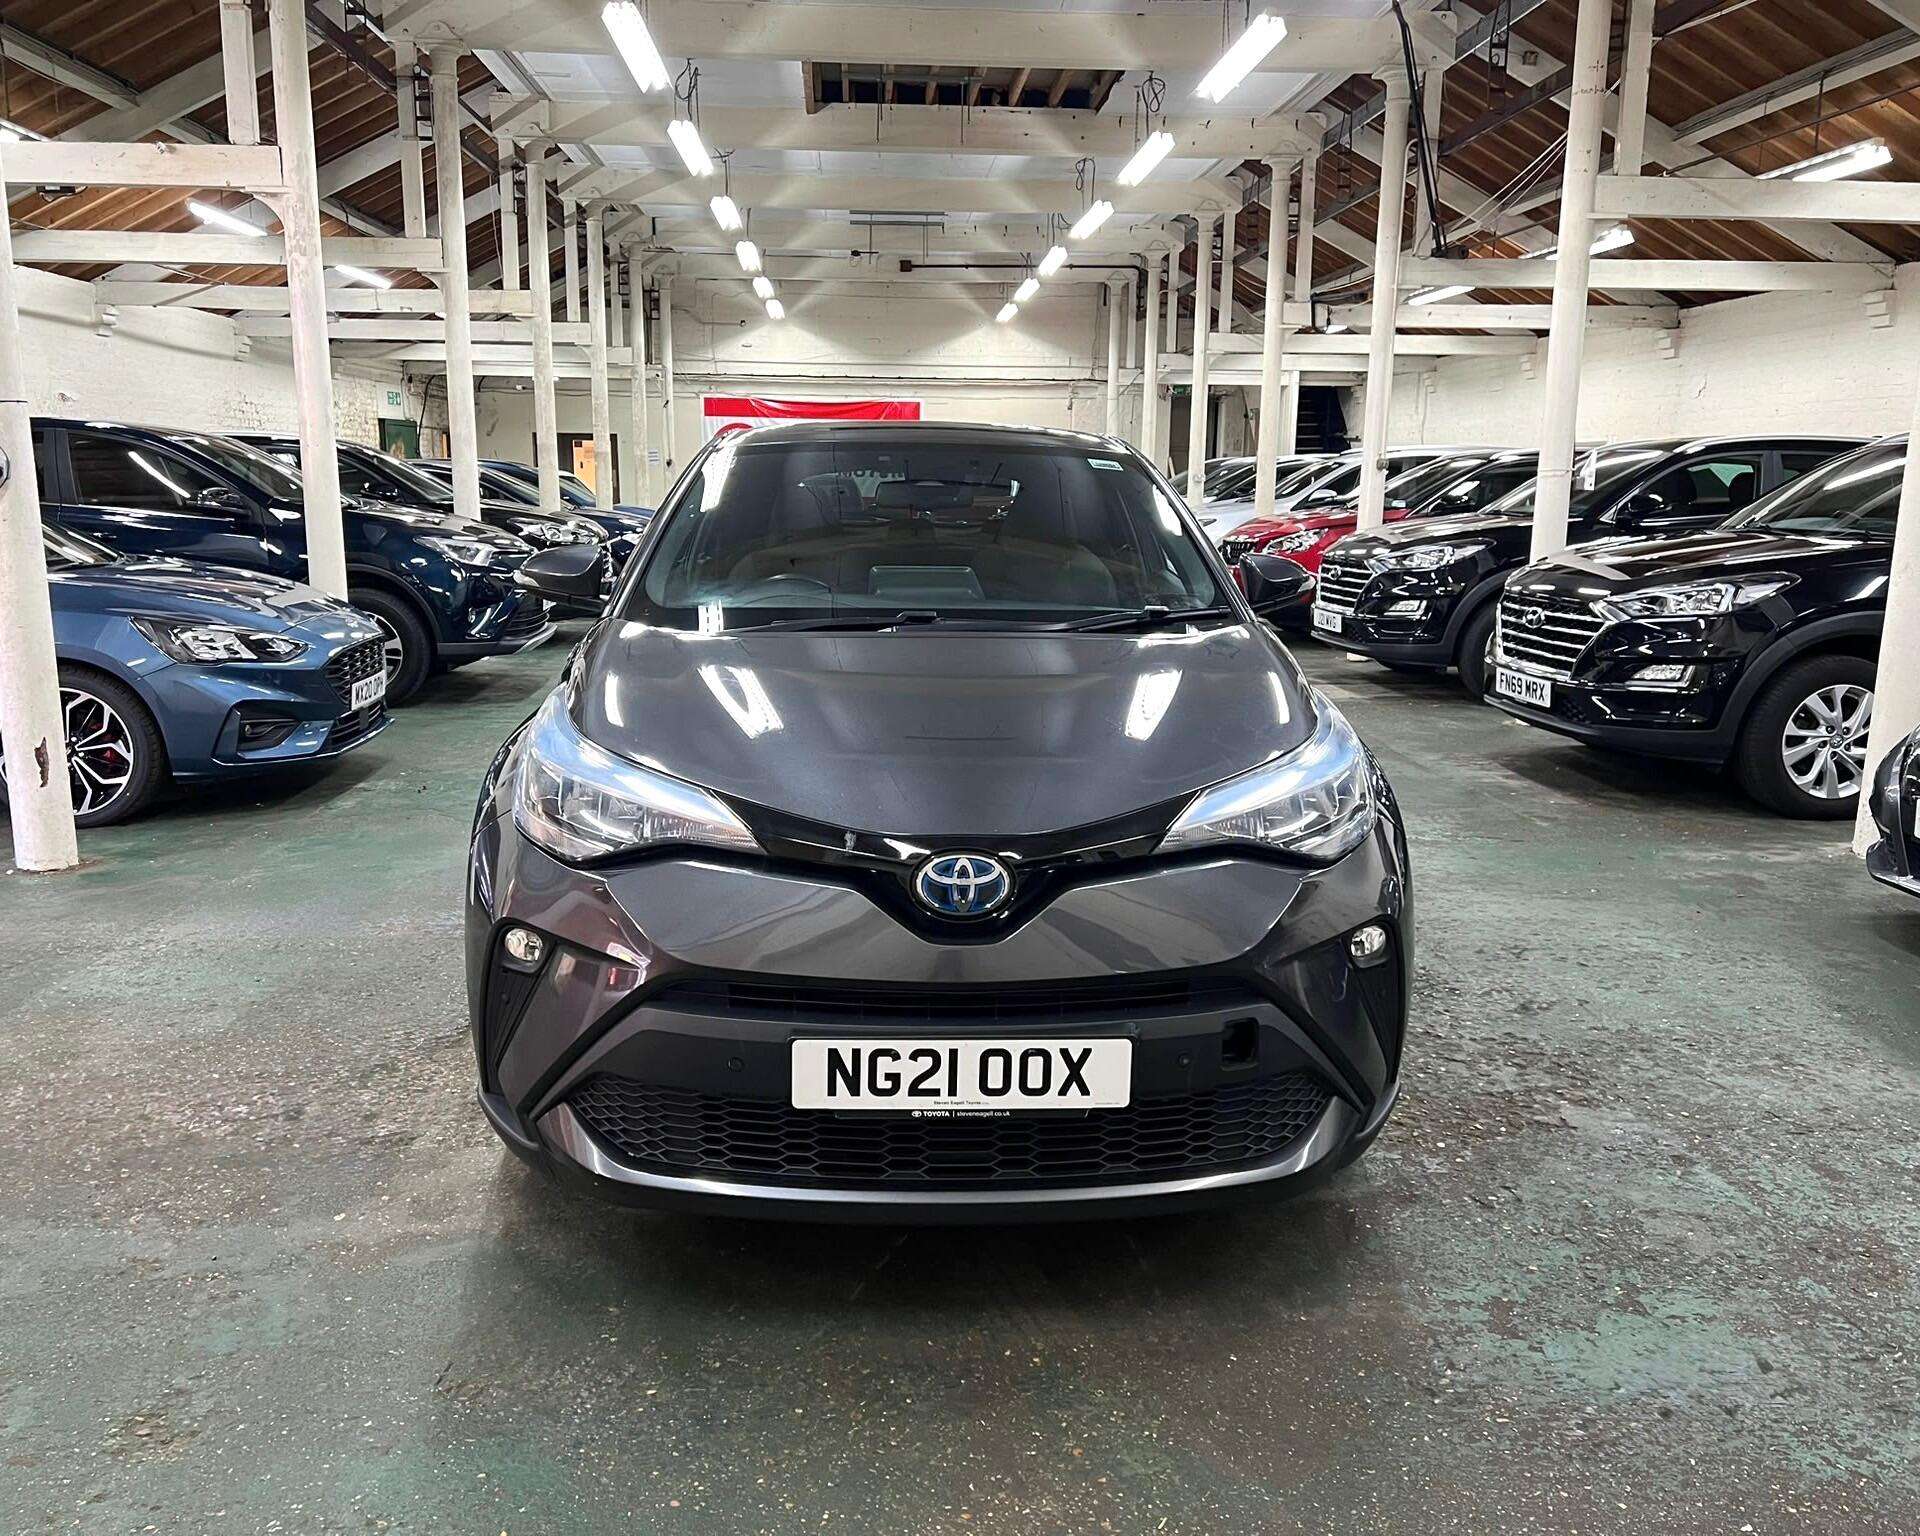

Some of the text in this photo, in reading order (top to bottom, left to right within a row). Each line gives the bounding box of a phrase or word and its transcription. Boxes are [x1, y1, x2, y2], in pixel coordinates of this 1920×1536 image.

[1500, 672, 1545, 702] FN69 MRX
[827, 1048, 1093, 1097] NG21 OOX
